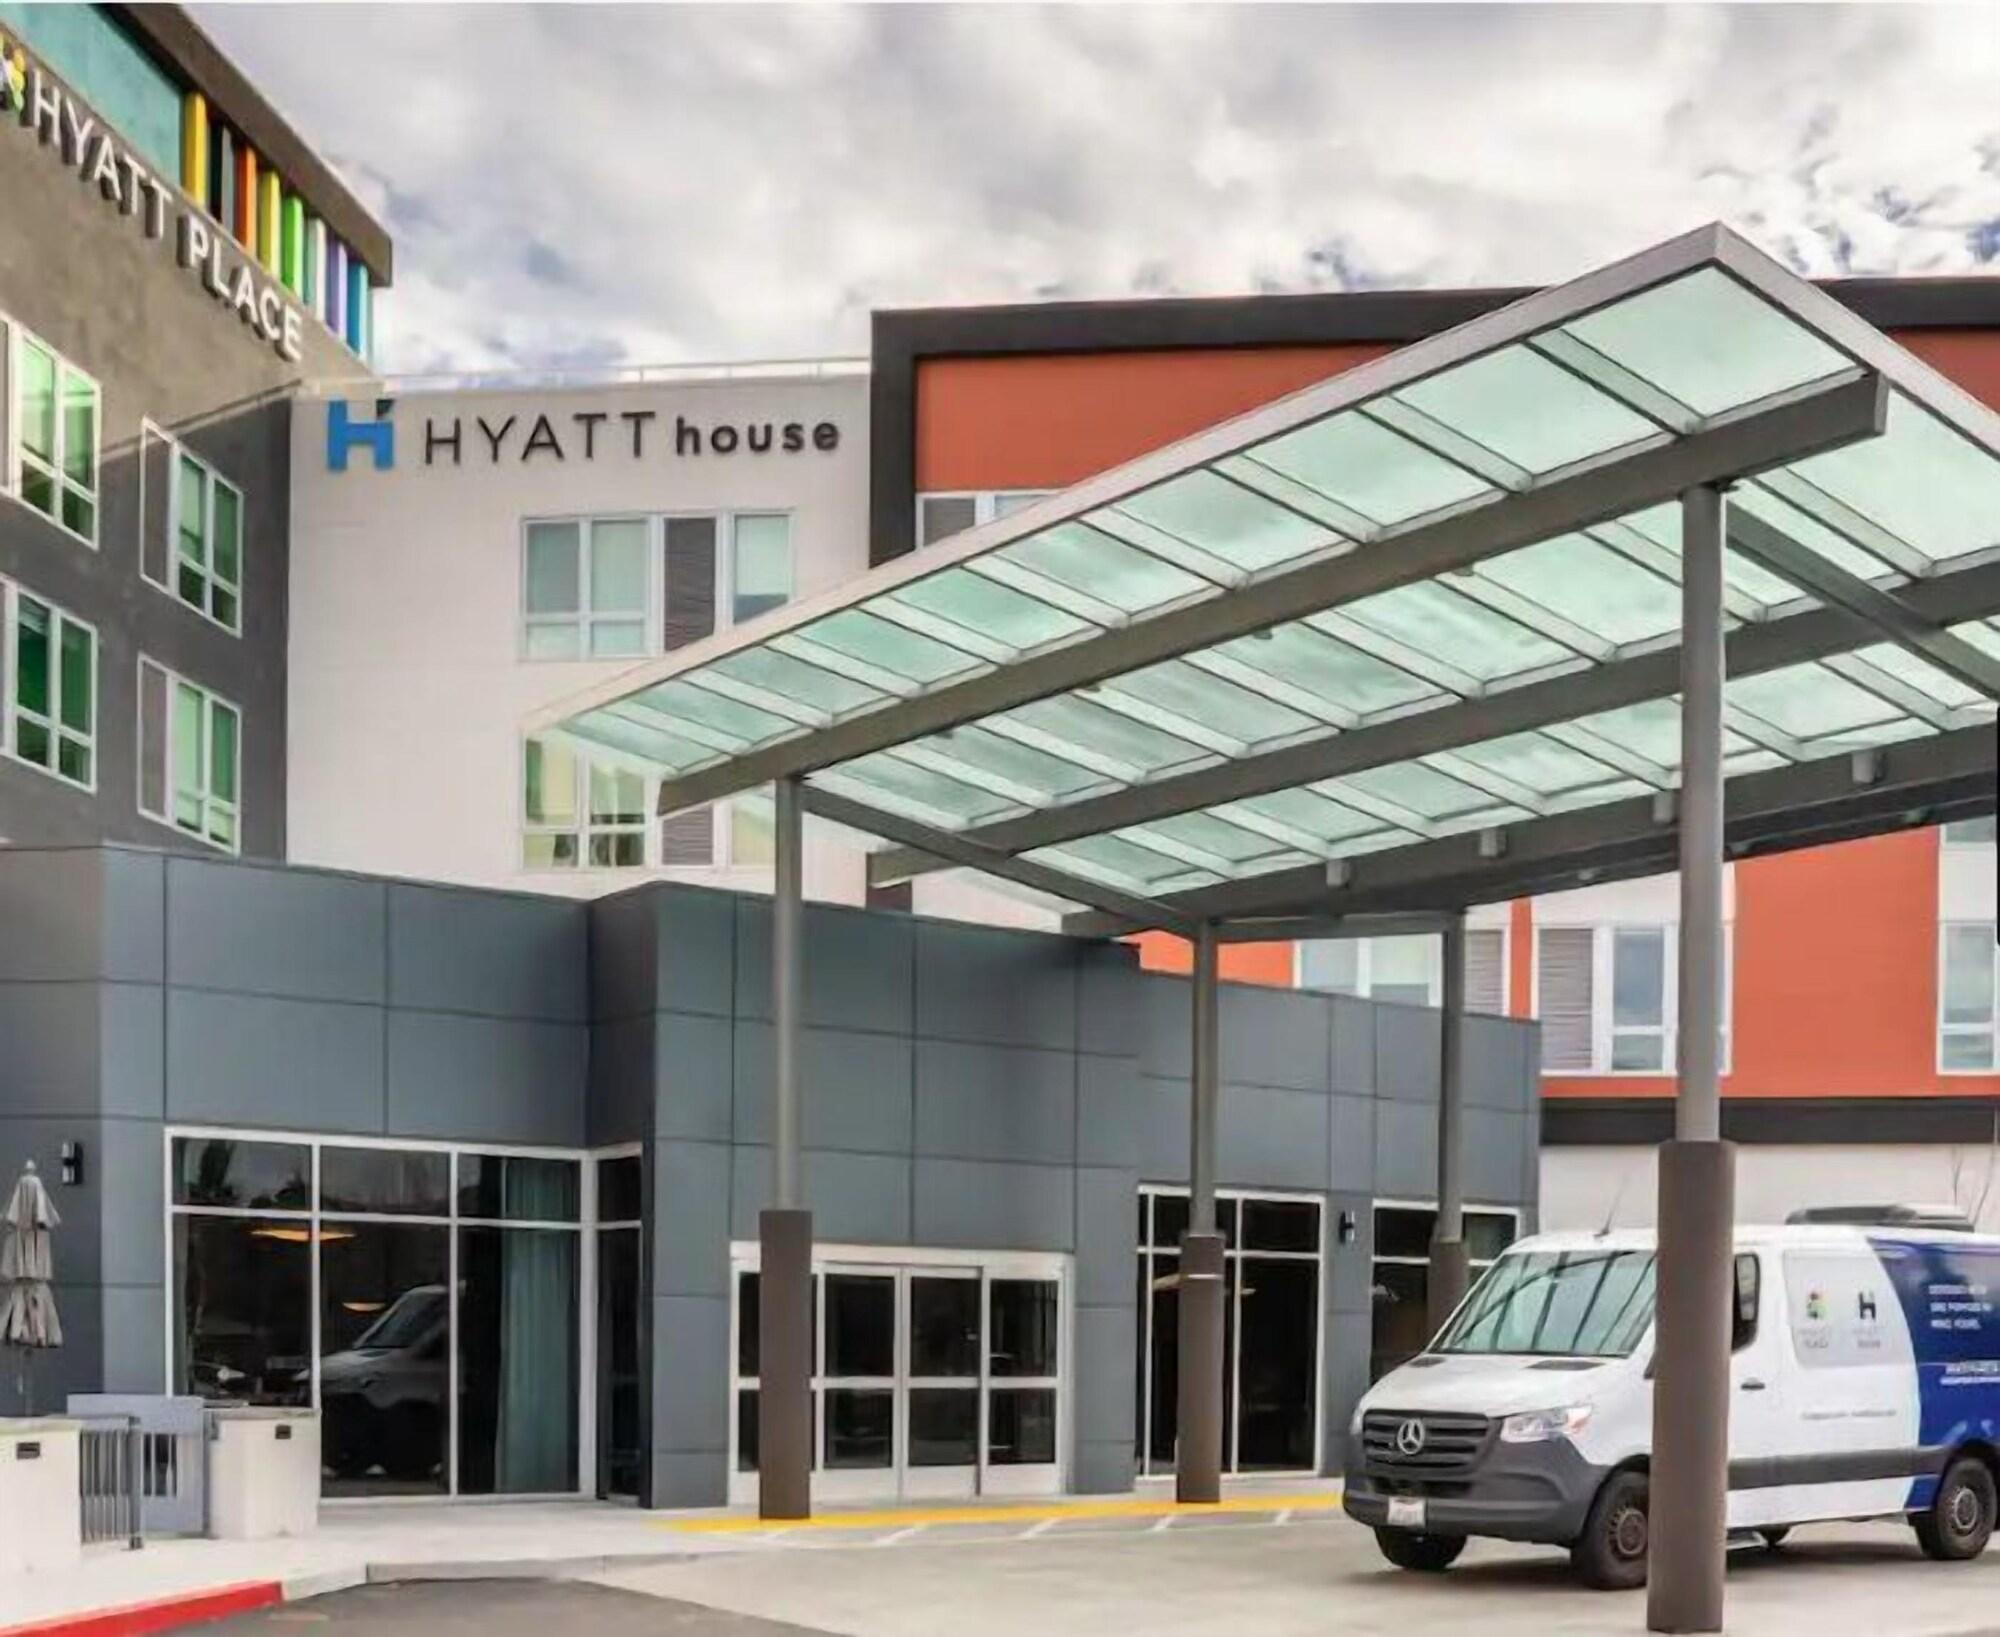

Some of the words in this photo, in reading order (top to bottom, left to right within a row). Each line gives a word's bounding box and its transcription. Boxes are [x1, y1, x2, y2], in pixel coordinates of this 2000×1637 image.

[33, 70, 172, 240] HYATT
[187, 213, 303, 362] PLACE
[424, 411, 656, 466] HYATT
[673, 415, 841, 456] house
